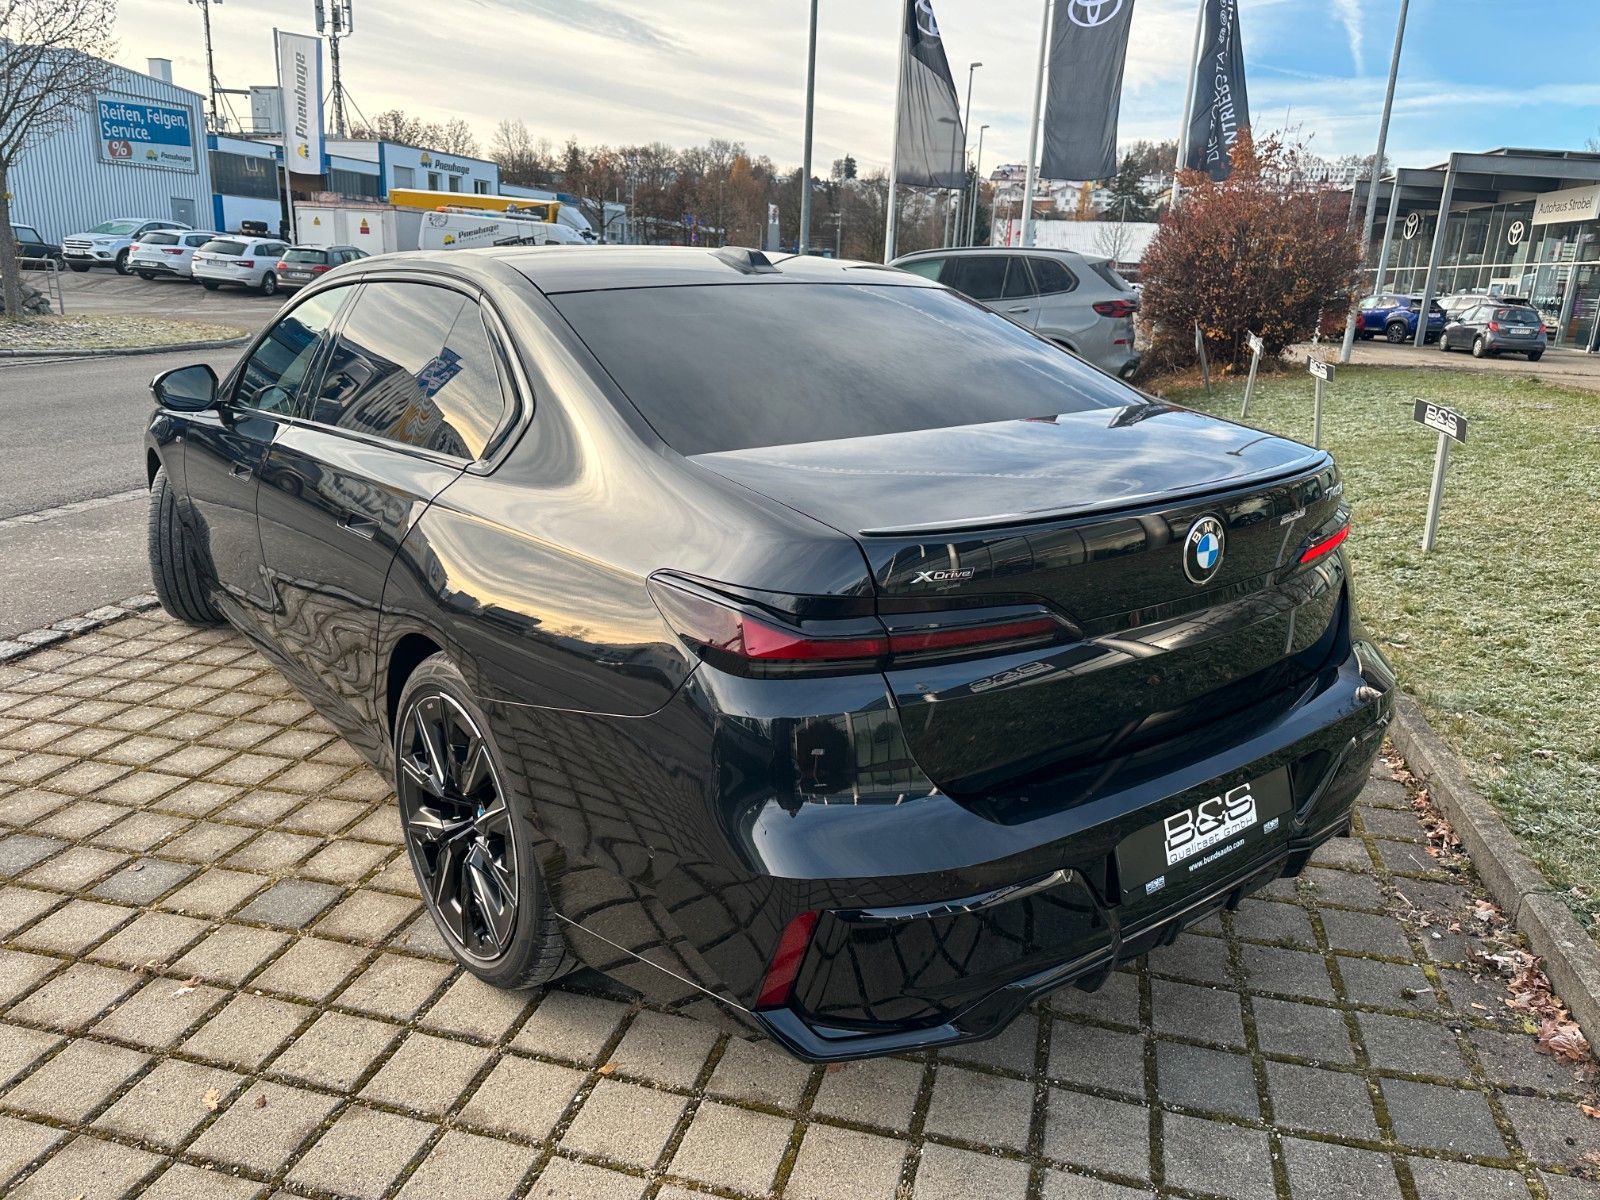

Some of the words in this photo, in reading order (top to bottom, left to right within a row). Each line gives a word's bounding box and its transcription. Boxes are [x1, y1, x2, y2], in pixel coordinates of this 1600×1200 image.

[295, 52, 309, 140] Pneuhage
[100, 103, 144, 125] Reifen,
[146, 108, 188, 130] Felgen,
[103, 121, 152, 140] Service.
[434, 159, 470, 175] Pneuhage
[1538, 202, 1568, 214] Autohaus
[1569, 196, 1593, 210] Strobel
[458, 224, 500, 240] Pneuhage
[1425, 404, 1458, 433] B&S
[1164, 783, 1253, 852] B&S
[1169, 832, 1221, 864] Qualitaet
[1223, 815, 1254, 838] GmbH
[1188, 838, 1245, 873] www.bundsauto.com
